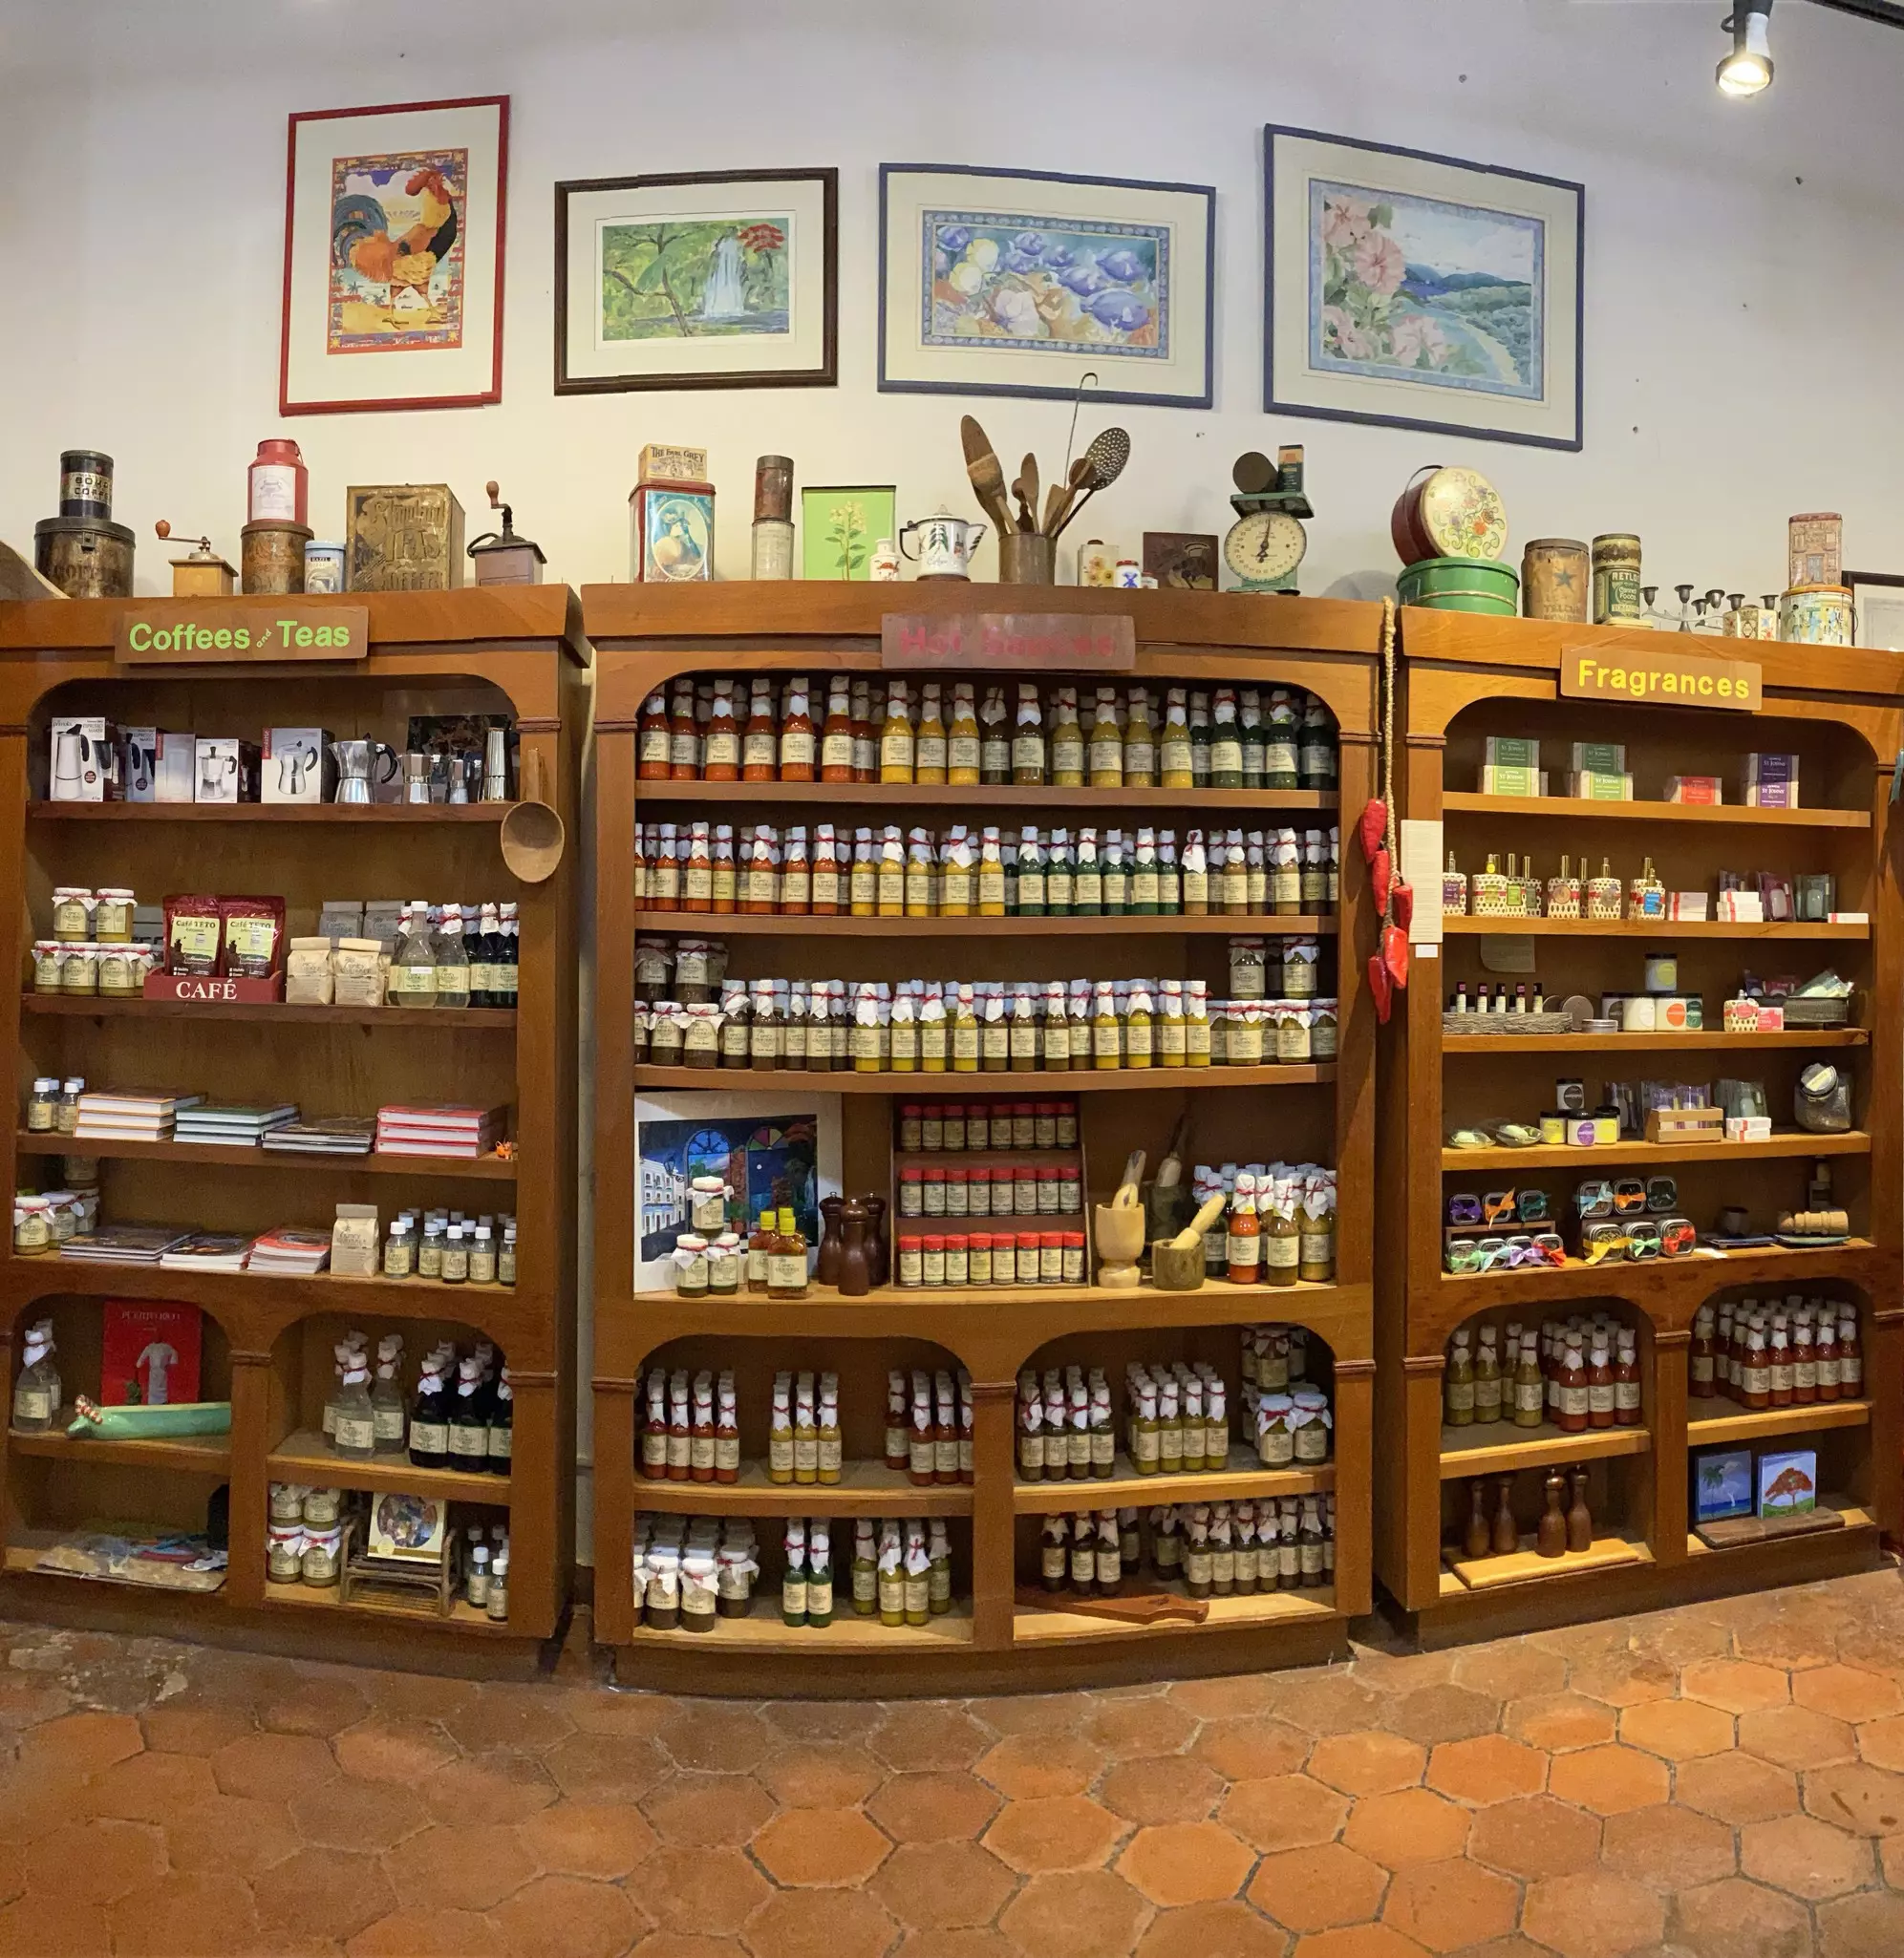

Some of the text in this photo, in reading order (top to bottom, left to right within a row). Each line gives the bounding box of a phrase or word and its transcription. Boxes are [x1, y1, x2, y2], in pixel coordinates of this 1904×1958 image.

[651, 446, 665, 458] THE
[683, 450, 705, 463] GREY
[1612, 571, 1640, 582] RETLO
[129, 620, 351, 651] Coffees and Teas
[900, 626, 962, 657] Hot
[1578, 659, 1750, 699] Fragrances
[176, 978, 238, 1000] CAFÉ
